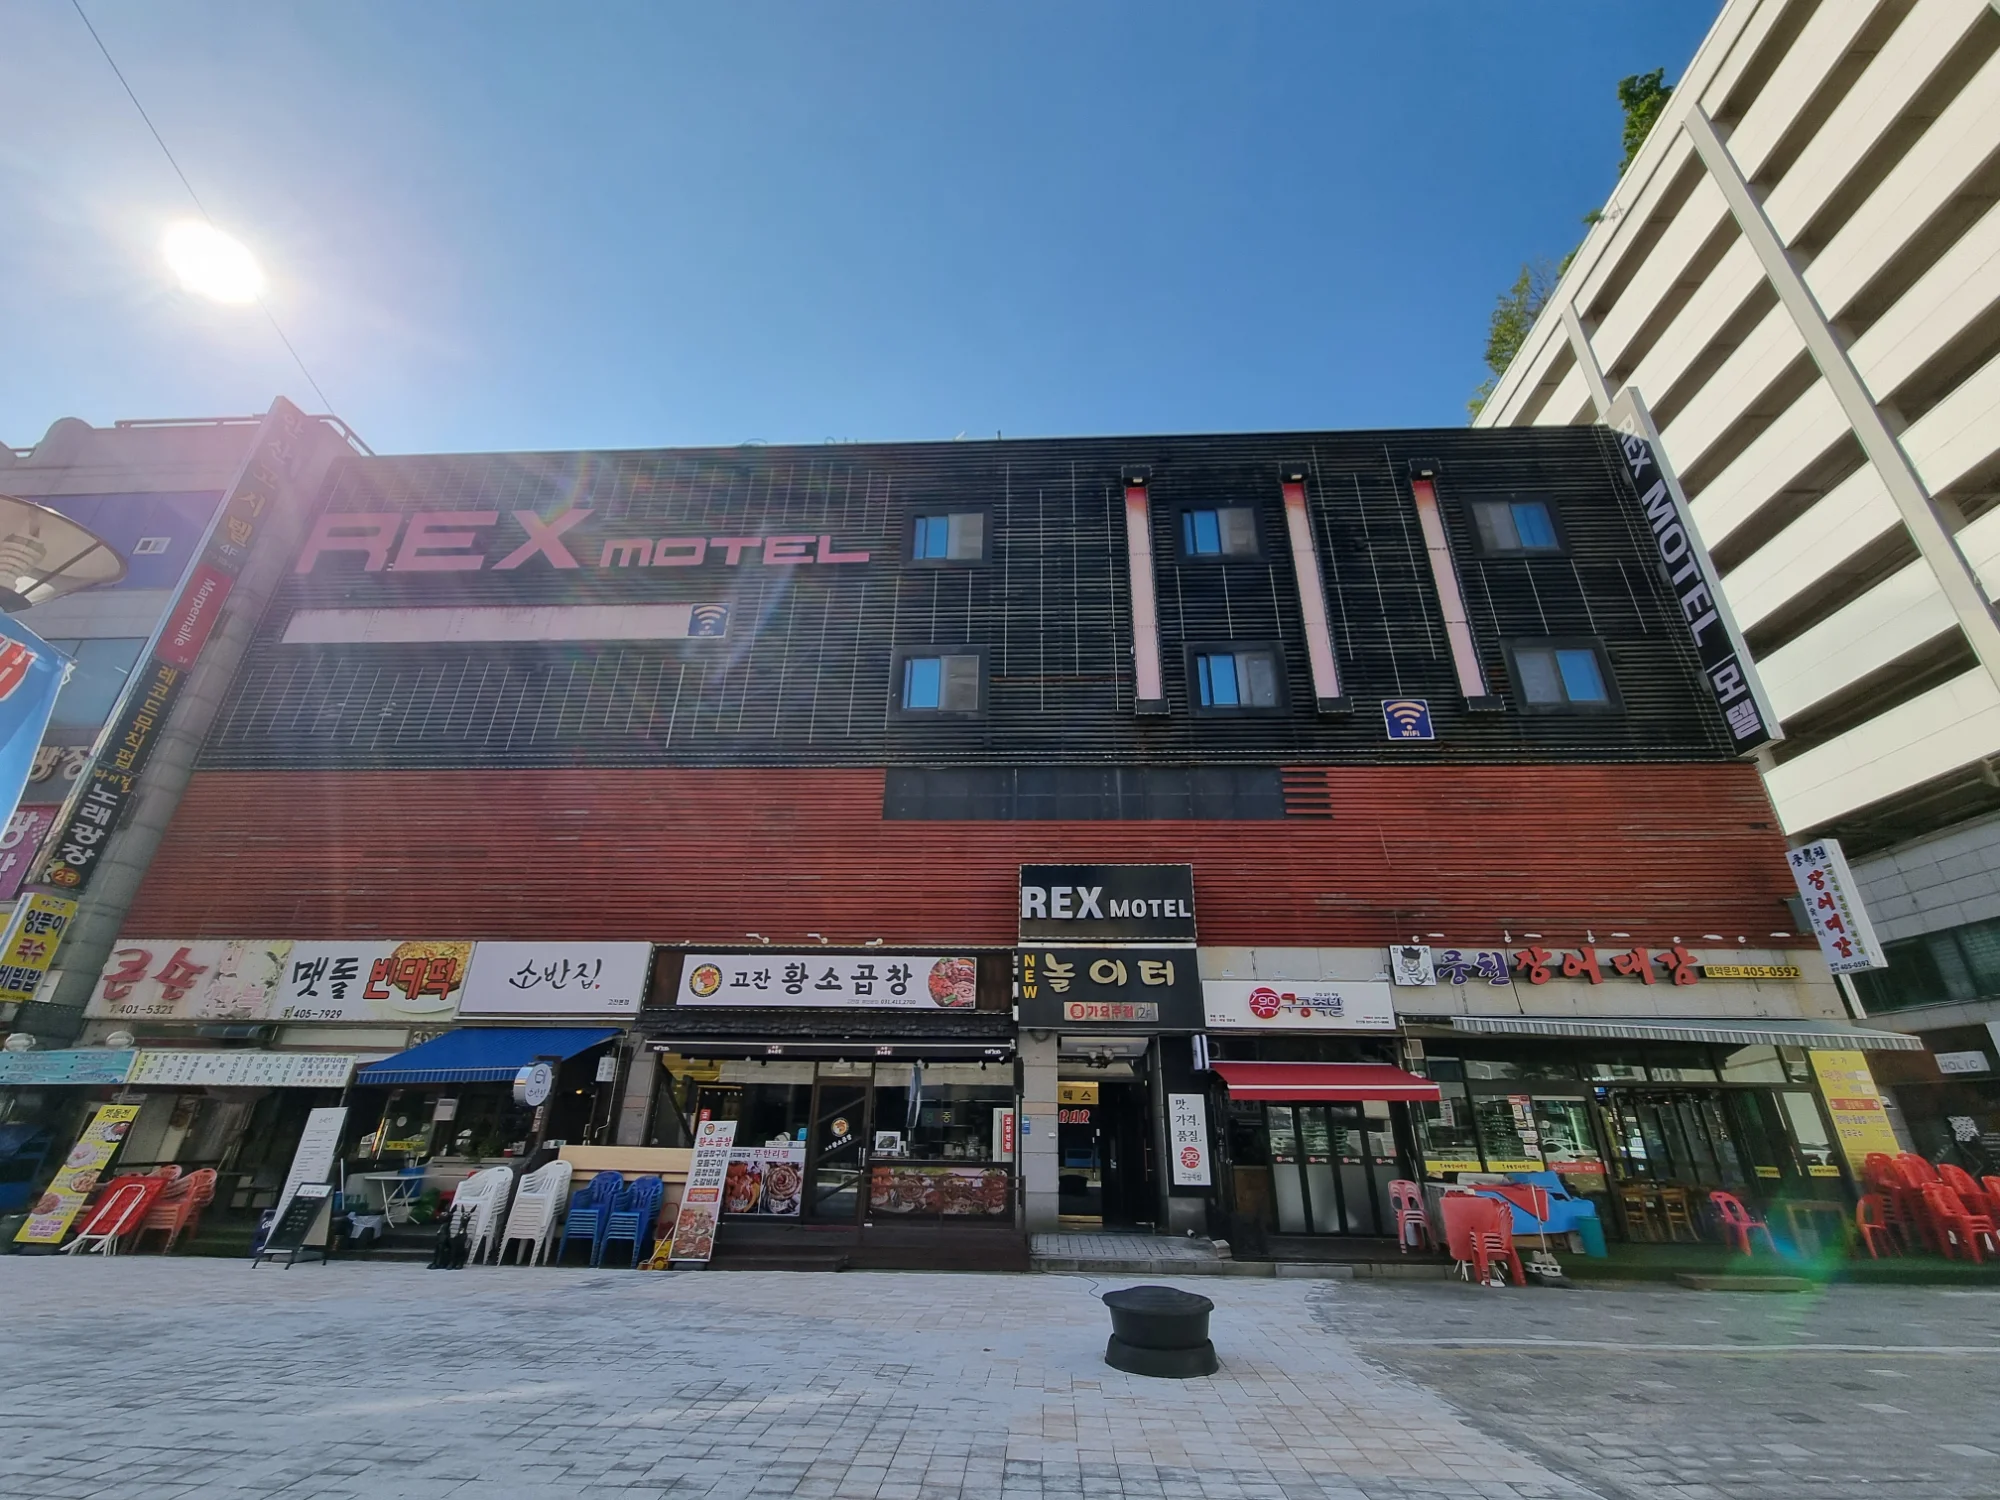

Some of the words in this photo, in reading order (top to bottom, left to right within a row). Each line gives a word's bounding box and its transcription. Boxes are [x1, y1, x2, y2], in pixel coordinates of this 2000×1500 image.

[295, 508, 595, 573] REX
[599, 535, 870, 567] MOTEL
[1641, 478, 1718, 648] MOTEL
[1712, 663, 1761, 741] 모텔
[62, 783, 118, 865] 노래광장
[1021, 886, 1104, 919] REX
[1109, 899, 1192, 918] MOTEL
[25, 909, 67, 938] 양푼이
[17, 938, 46, 964] 국수
[292, 957, 358, 999] 맷돌
[363, 957, 456, 1000] 빈대떡
[509, 959, 603, 990] 소반집
[729, 968, 771, 989] 고잔
[781, 962, 912, 995] 황소곱창
[1023, 955, 1038, 999] NEW
[1042, 953, 1175, 993] 놀이터
[1706, 966, 1741, 977] 예약문의
[1743, 966, 1799, 977] 405-0592
[1087, 1004, 1134, 1018] 가요주점
[1258, 996, 1277, 1006] 90
[1281, 993, 1345, 1017] 구공족발
[1059, 1109, 1090, 1123] BAR
[699, 1137, 732, 1147] 황소곱창
[753, 1149, 790, 1158] 무한리필
